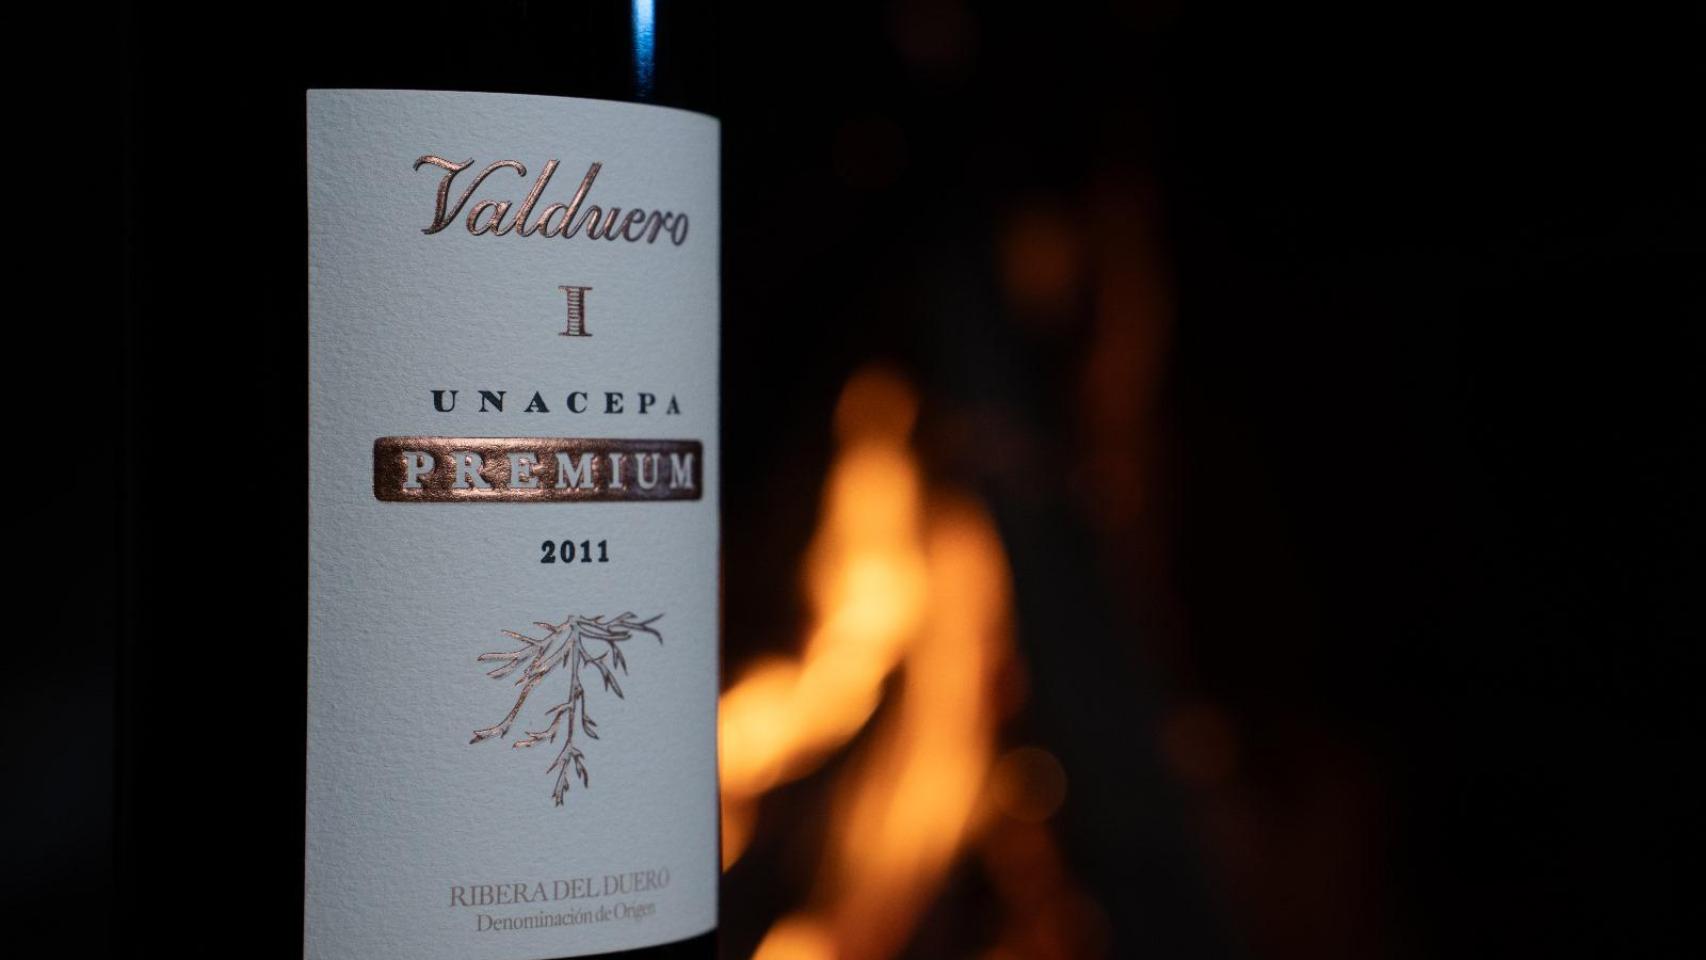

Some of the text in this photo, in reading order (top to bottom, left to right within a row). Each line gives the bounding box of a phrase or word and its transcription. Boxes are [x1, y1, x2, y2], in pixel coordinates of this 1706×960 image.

[413, 155, 689, 246] Valduero
[558, 285, 593, 337] I
[401, 450, 695, 490] PREMIUM
[540, 540, 610, 564] 2011
[450, 867, 671, 908] RIBERA DEL DUERO
[476, 901, 657, 932] Denominación de Origen
